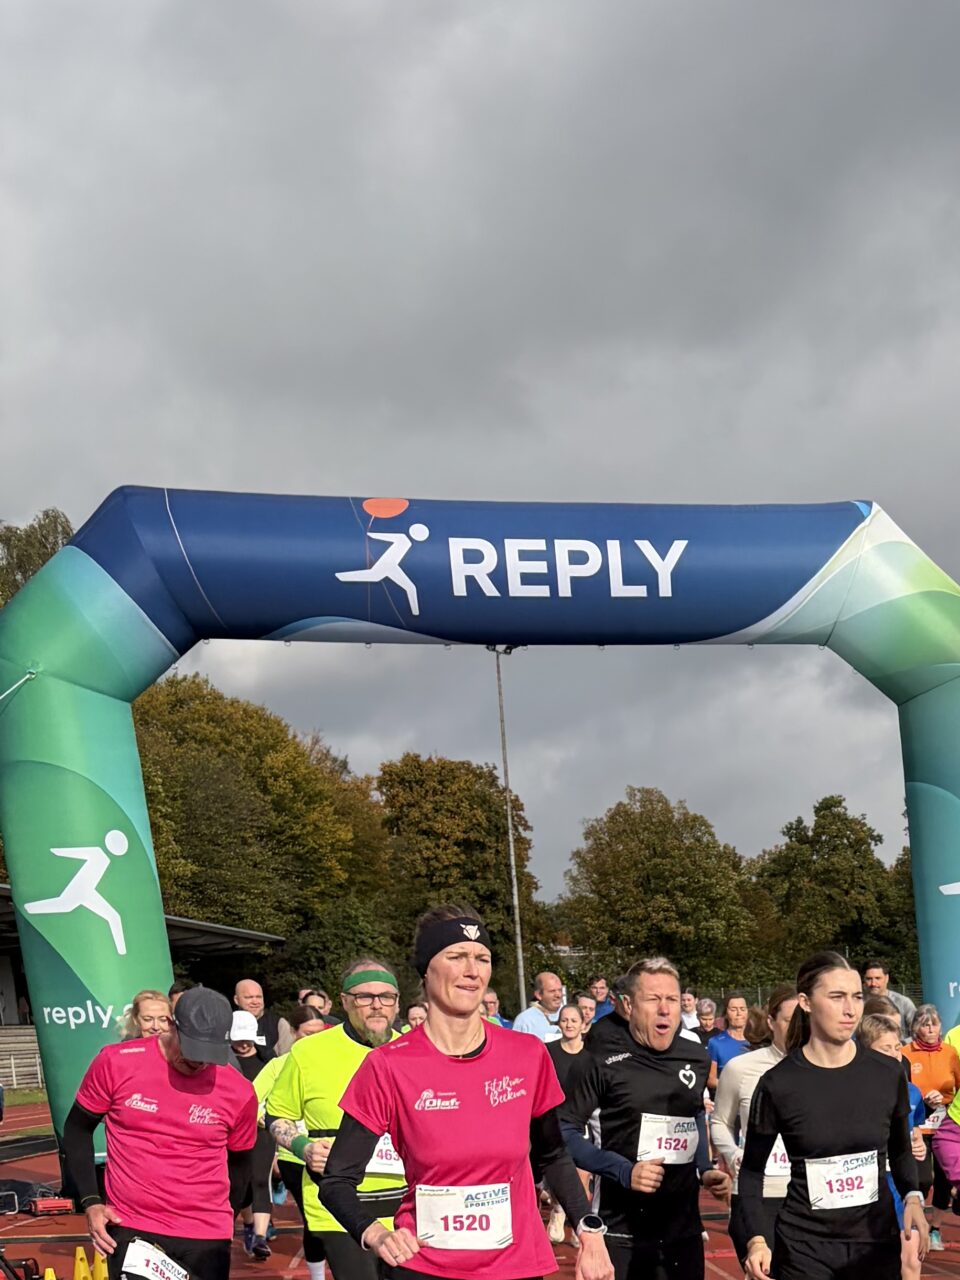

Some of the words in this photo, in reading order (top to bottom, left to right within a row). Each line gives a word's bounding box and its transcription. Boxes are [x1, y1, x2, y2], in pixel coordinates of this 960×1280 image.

[449, 537, 689, 598] REPLY
[656, 1137, 688, 1151] 1524
[375, 1148, 400, 1161] 463
[771, 1152, 787, 1164] 14
[825, 1175, 865, 1194] 1392
[440, 1214, 491, 1232] 1520
